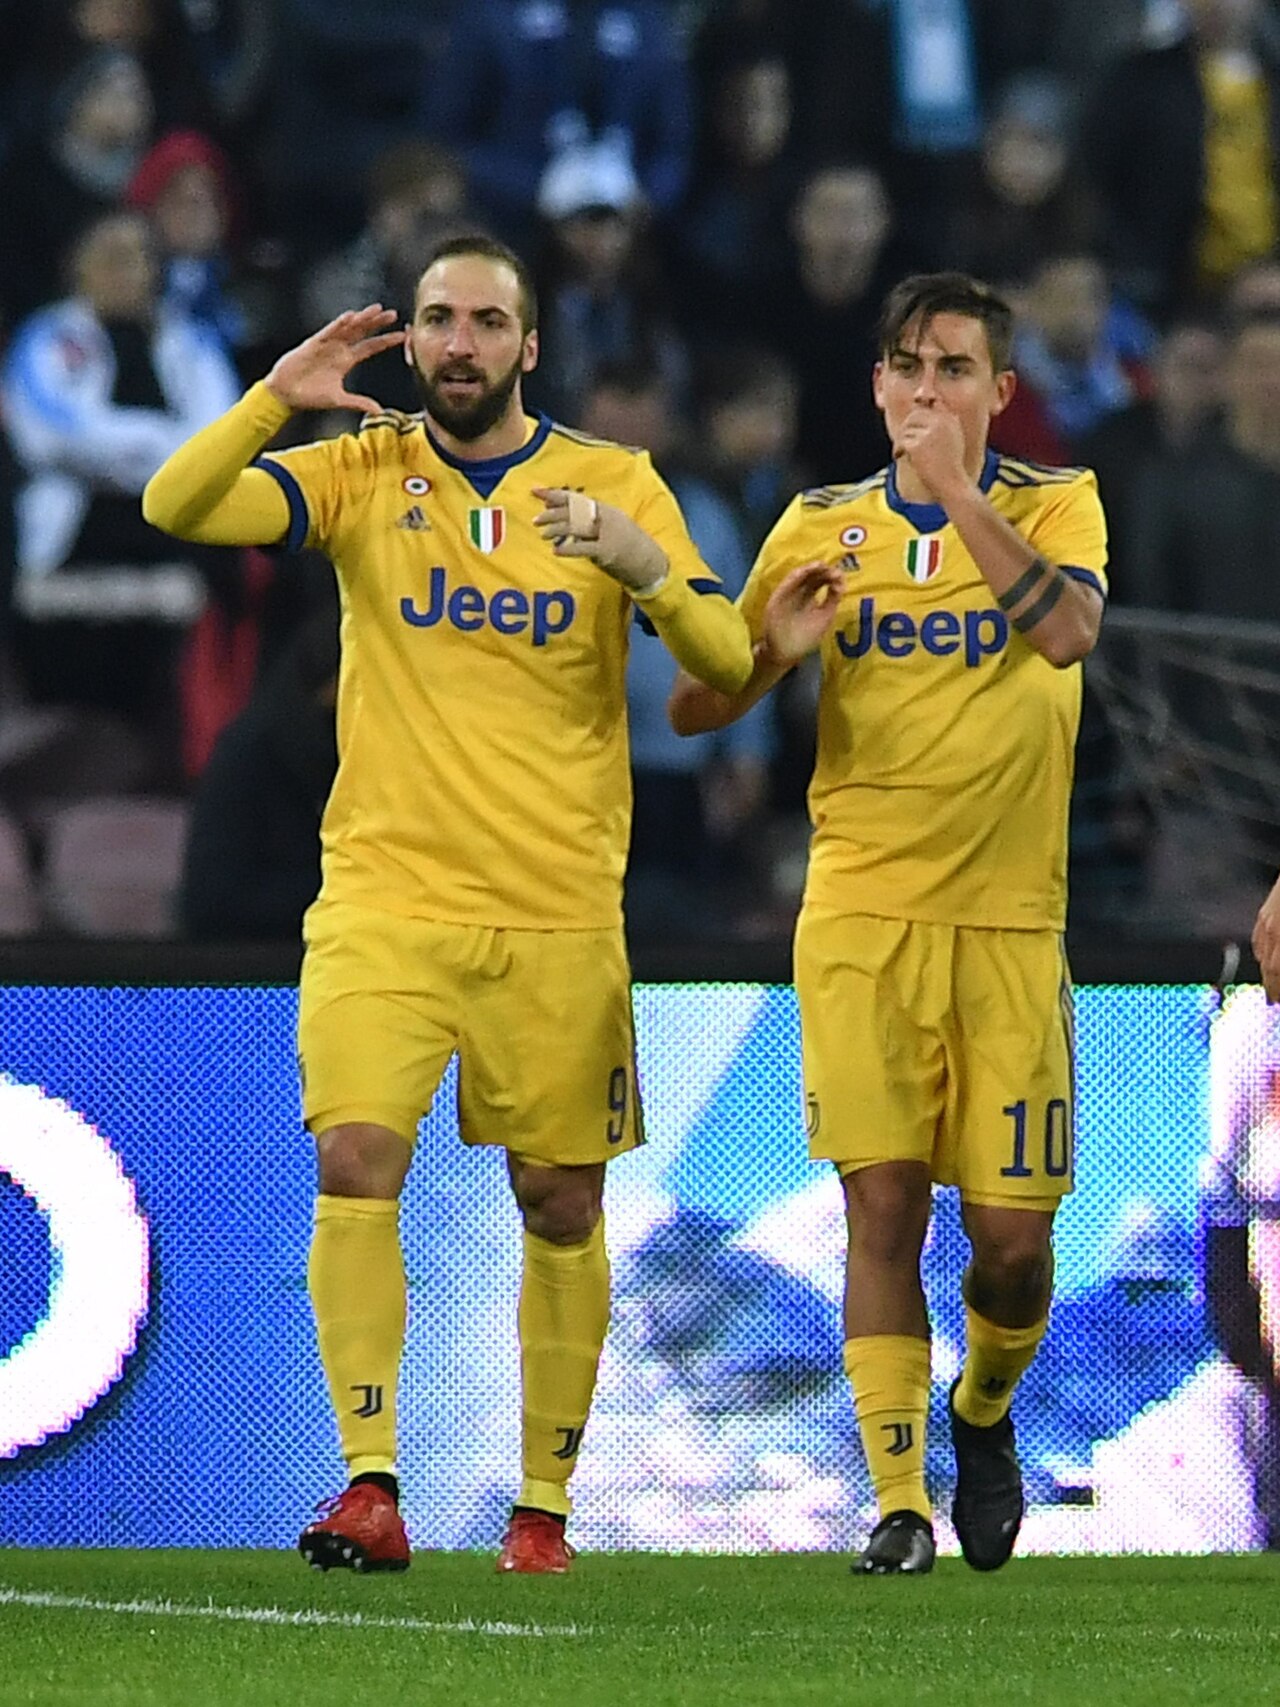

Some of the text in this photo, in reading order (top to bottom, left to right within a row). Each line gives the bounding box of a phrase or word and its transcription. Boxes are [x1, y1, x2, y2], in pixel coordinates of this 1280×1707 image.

[400, 566, 576, 647] Jeep
[834, 596, 1009, 668] Jeep
[606, 1066, 627, 1145] 9
[1000, 1098, 1068, 1177] 10
